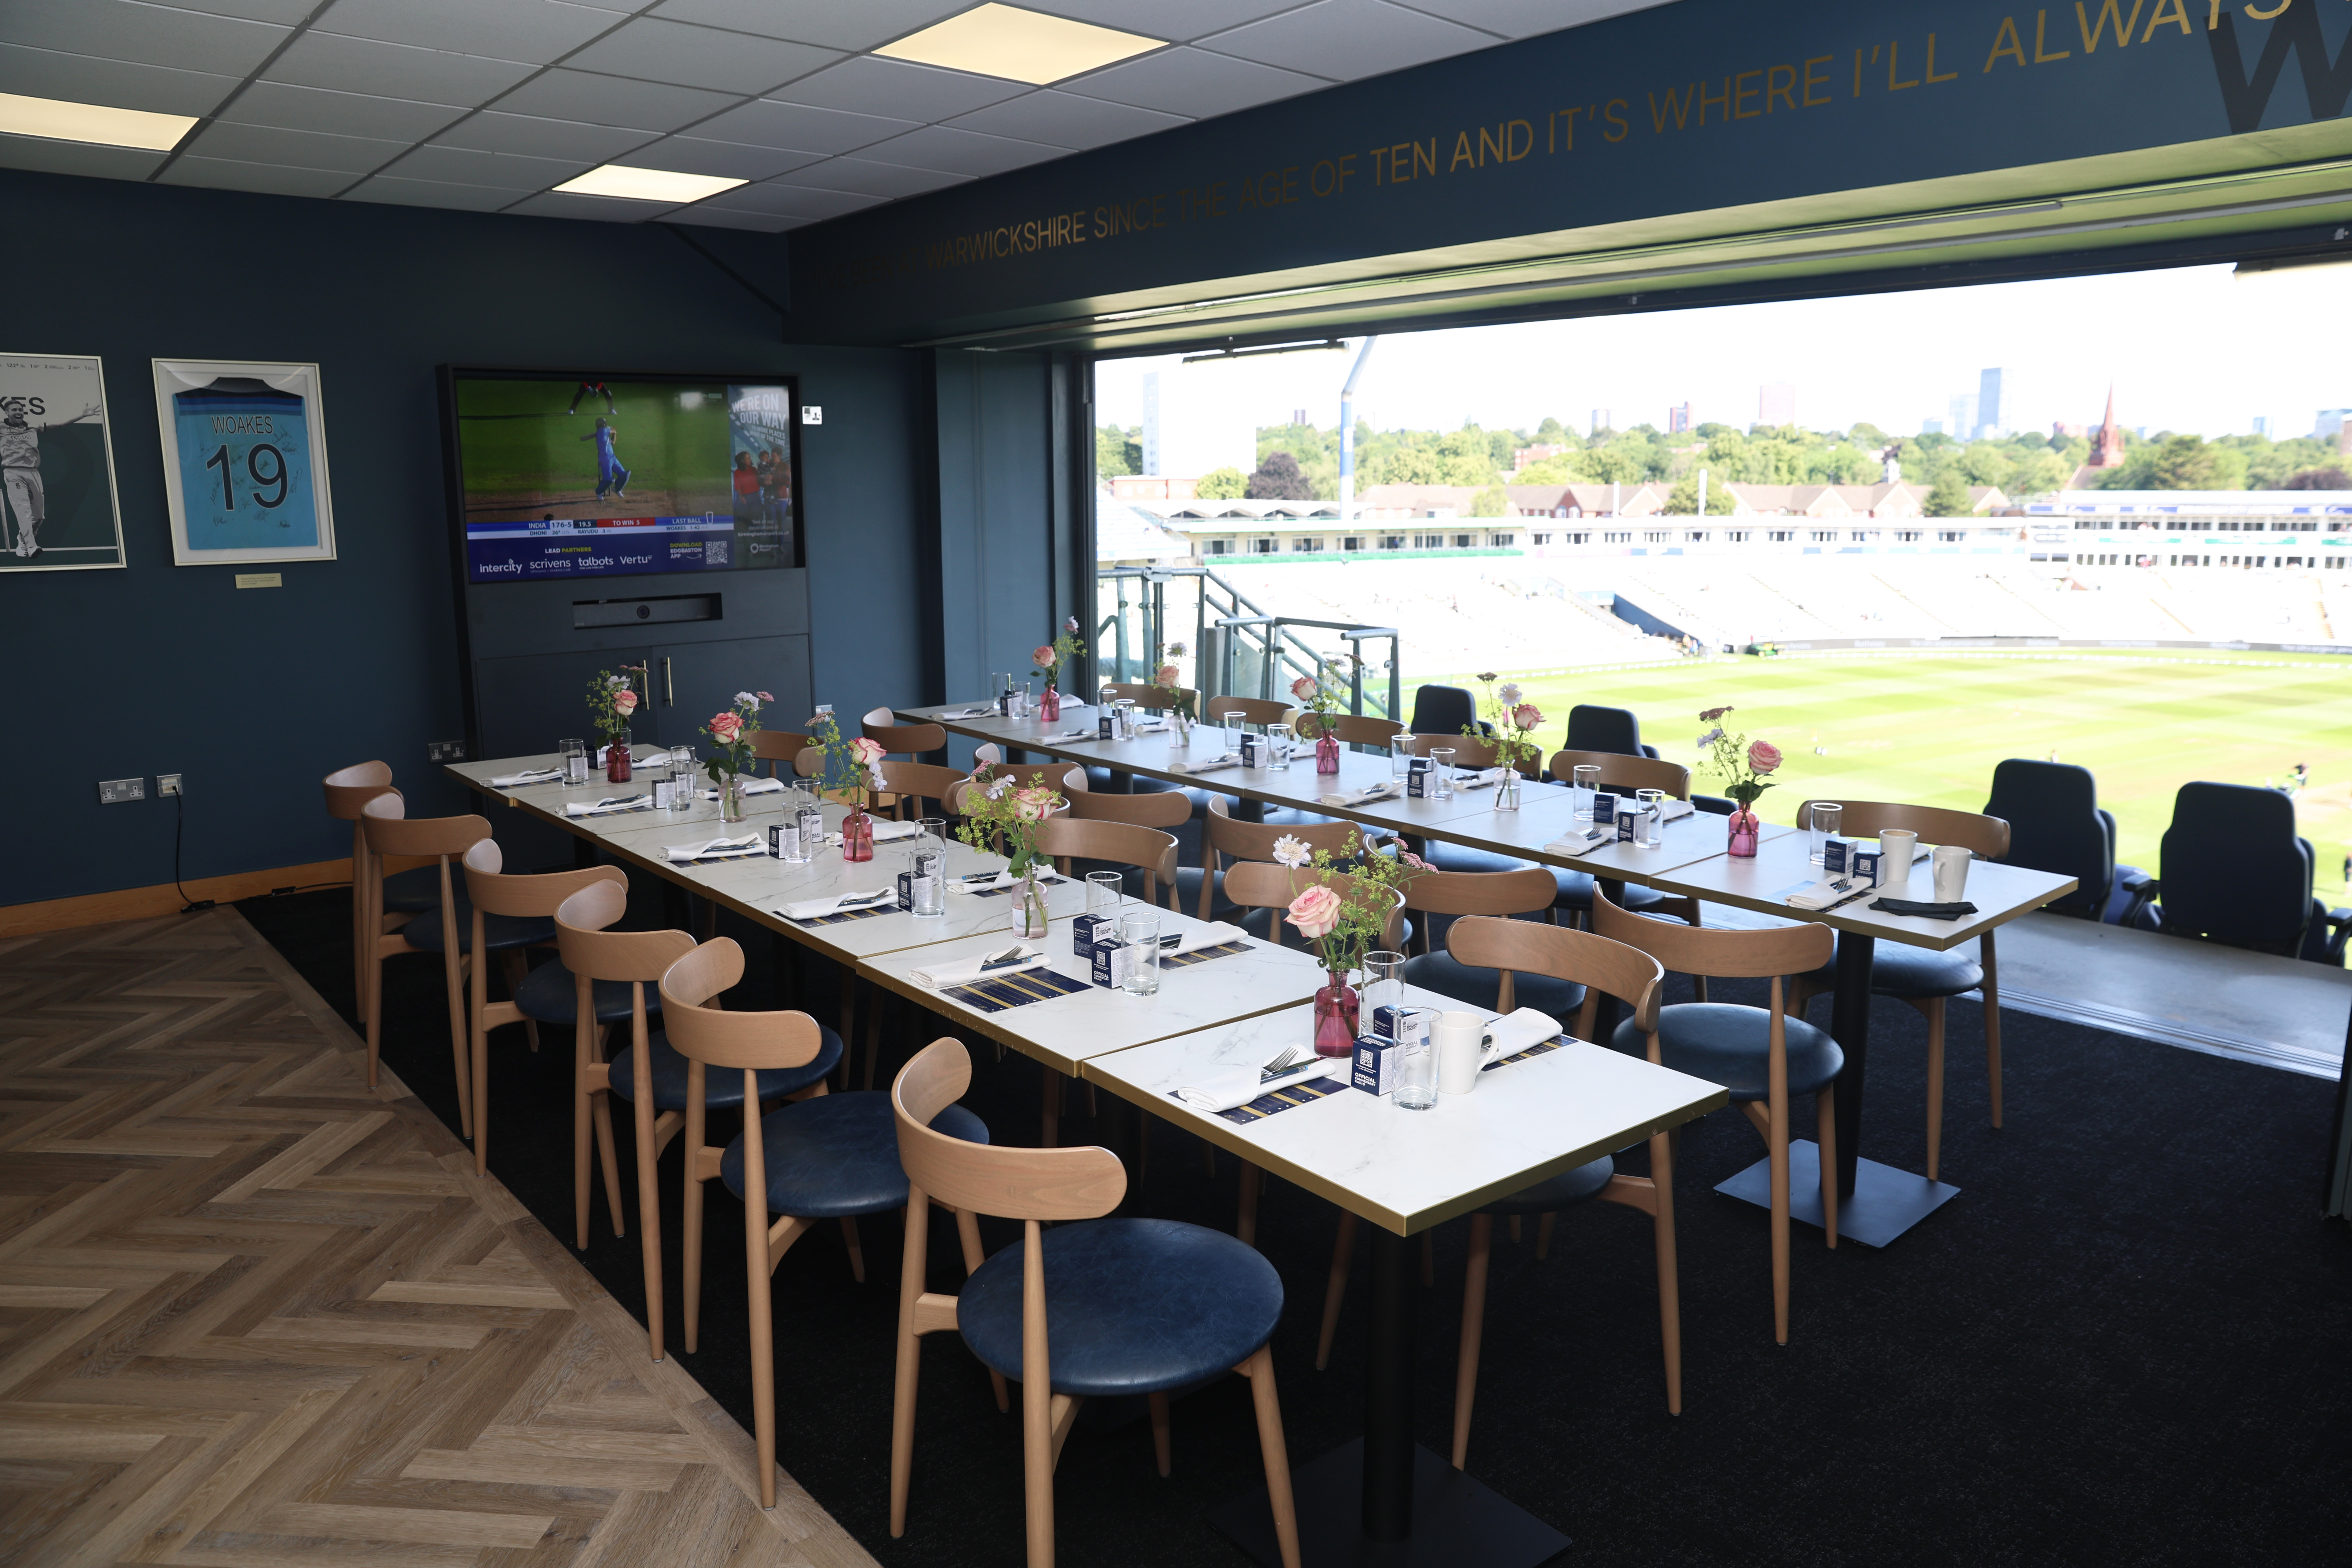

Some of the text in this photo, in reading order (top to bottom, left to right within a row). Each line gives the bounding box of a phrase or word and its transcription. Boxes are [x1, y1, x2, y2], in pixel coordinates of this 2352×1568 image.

[899, 247, 919, 276] AT
[926, 211, 1086, 270] WARWICKSHIRE
[1094, 193, 1167, 239] SINCE
[1177, 181, 1228, 222] THE
[1238, 167, 1299, 211] AGE
[1311, 157, 1356, 197] OF
[1370, 137, 1436, 187] TEN
[1450, 119, 1534, 172] AND
[1548, 98, 1630, 154] IT'S
[1648, 54, 1833, 134] WHERE
[1853, 32, 1958, 98] I'LL
[732, 395, 761, 413] WE'RE
[762, 393, 779, 411] ON
[211, 416, 273, 435] WOAKES
[740, 411, 786, 430] OUR WAY
[206, 443, 288, 512] 19
[530, 559, 571, 569] scrivens
[578, 556, 613, 566] talbots
[619, 555, 648, 565] Vertu
[480, 560, 523, 574] intercity
[1094, 970, 1109, 979] OFFICIAL
[1365, 1037, 1387, 1046] OFFICIAL
[1354, 1076, 1376, 1087] COMMENTARY
[1355, 1072, 1376, 1083] OFFICIAL
